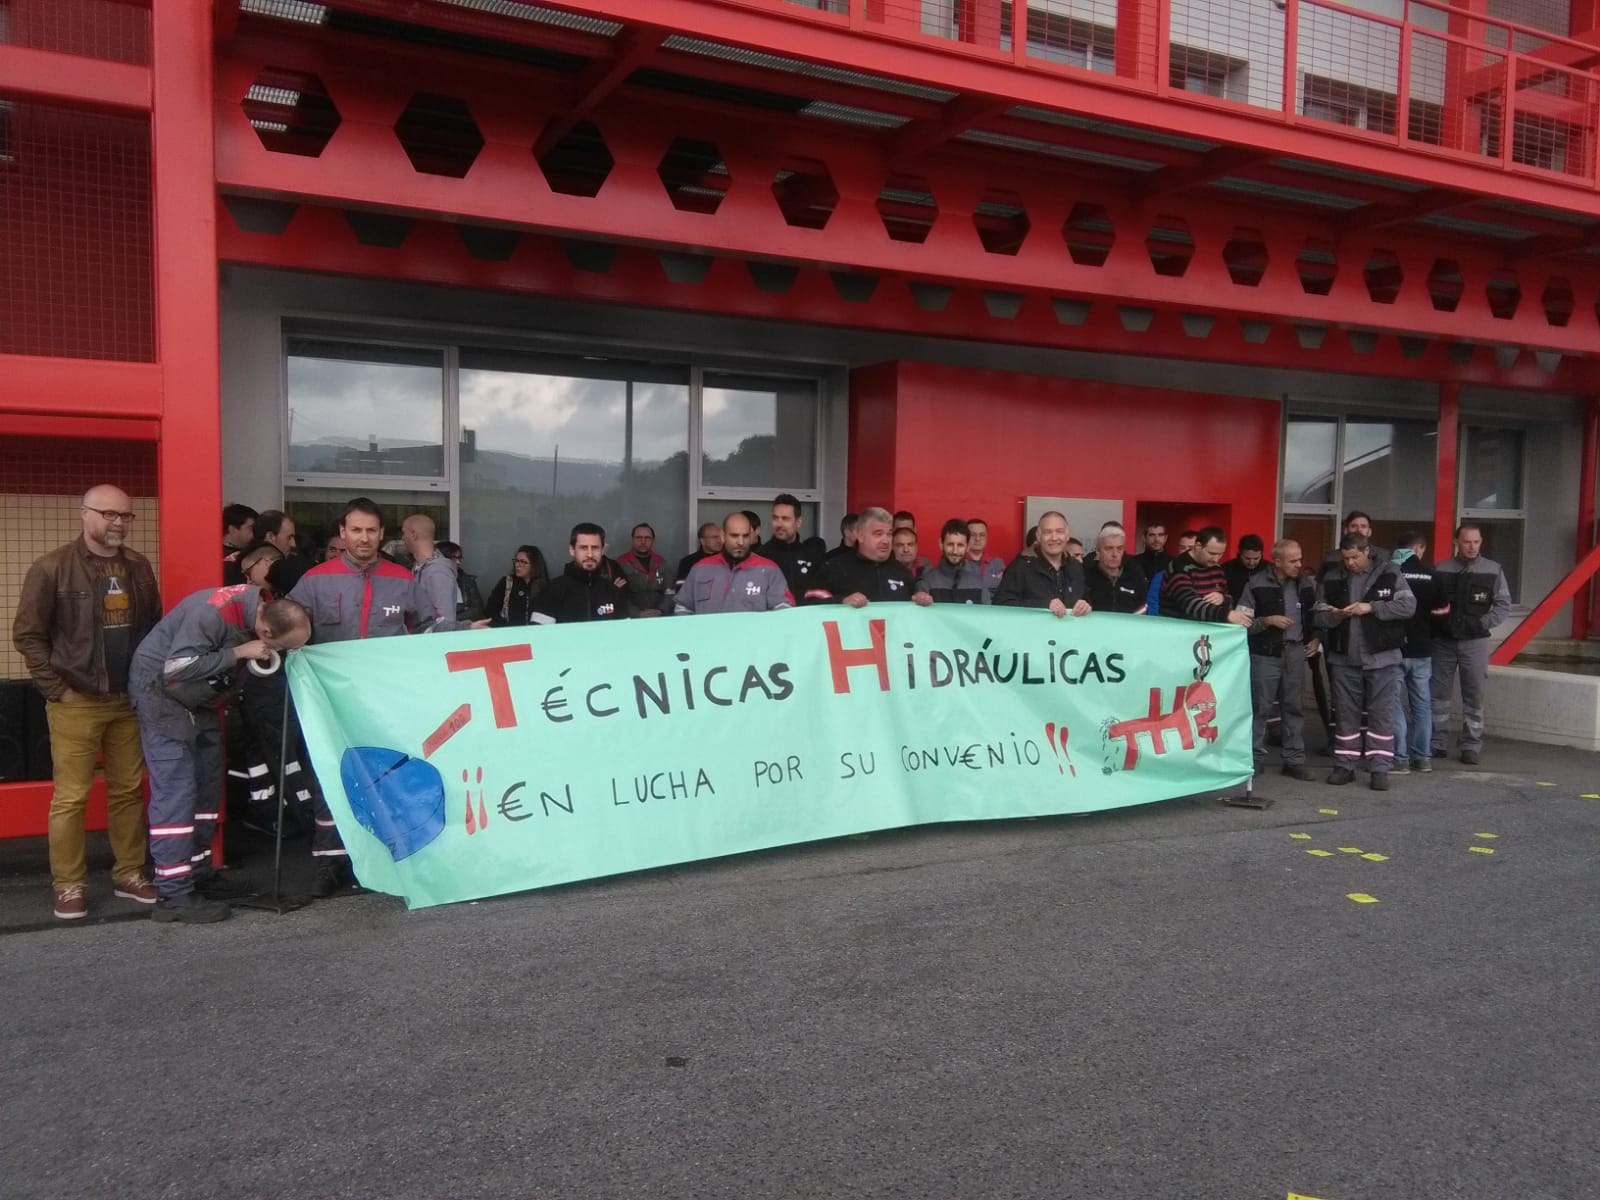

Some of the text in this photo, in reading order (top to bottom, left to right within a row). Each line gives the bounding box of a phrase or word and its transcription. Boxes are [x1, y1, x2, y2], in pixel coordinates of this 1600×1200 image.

[1377, 588, 1391, 597] TH
[383, 605, 401, 617] TH
[822, 618, 1126, 694] HIDRÁULICAS
[612, 766, 716, 806] LUCHA
[755, 754, 803, 788] POR
[840, 750, 876, 780] SU
